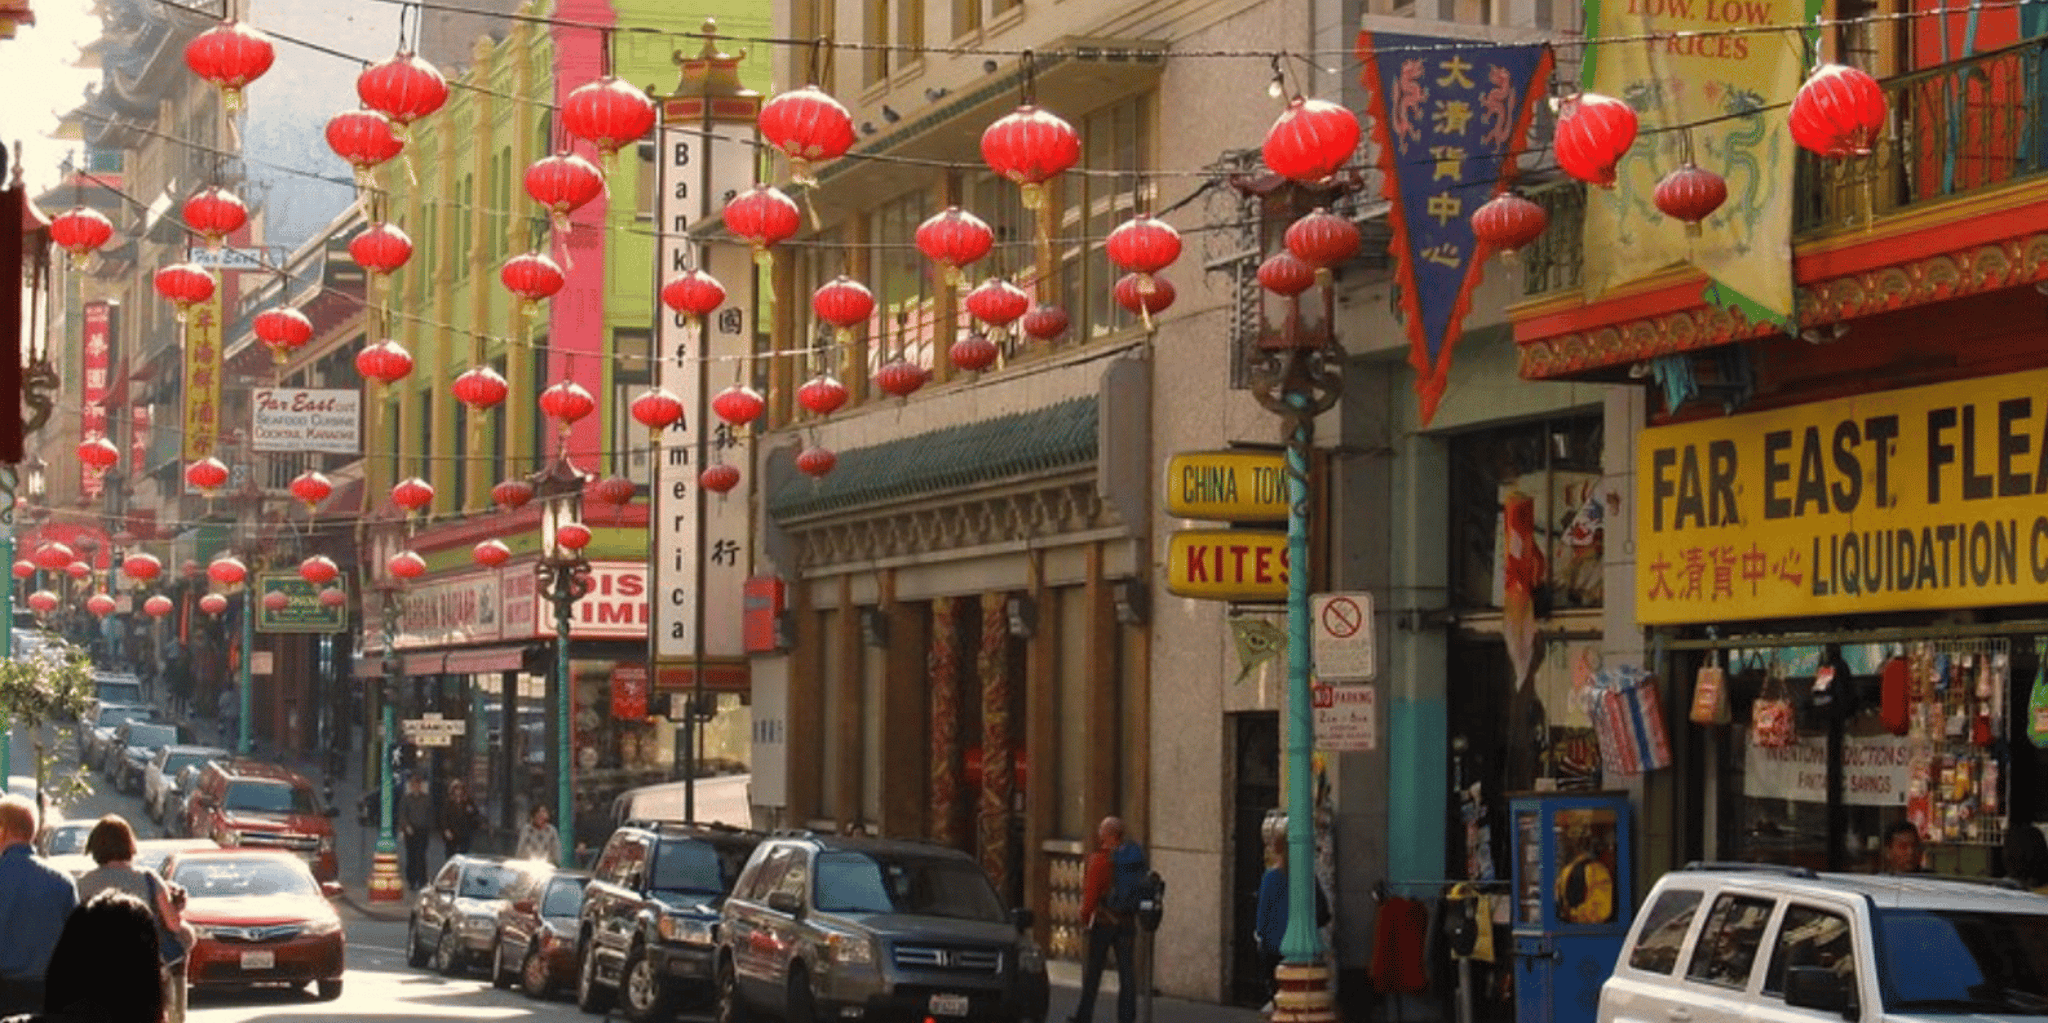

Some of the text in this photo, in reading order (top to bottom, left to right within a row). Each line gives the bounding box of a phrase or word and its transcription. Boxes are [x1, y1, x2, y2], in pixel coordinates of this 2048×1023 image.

[1704, 0, 1773, 25] LOW.
[1420, 55, 1475, 269] 大清貨中心
[673, 142, 689, 271] Bank
[256, 391, 288, 412] Far
[291, 391, 337, 412] East
[711, 189, 743, 567] 國銀行
[1183, 464, 1239, 504] CHINA
[1652, 439, 1740, 532] FAR
[1764, 415, 1899, 519] EAST
[670, 404, 688, 639] America
[1647, 542, 1803, 601] 大清貨中心
[1812, 519, 2018, 597] LIQUIDATION
[1334, 691, 1373, 704] PARKING
[1843, 745, 1896, 768] DUCTION
